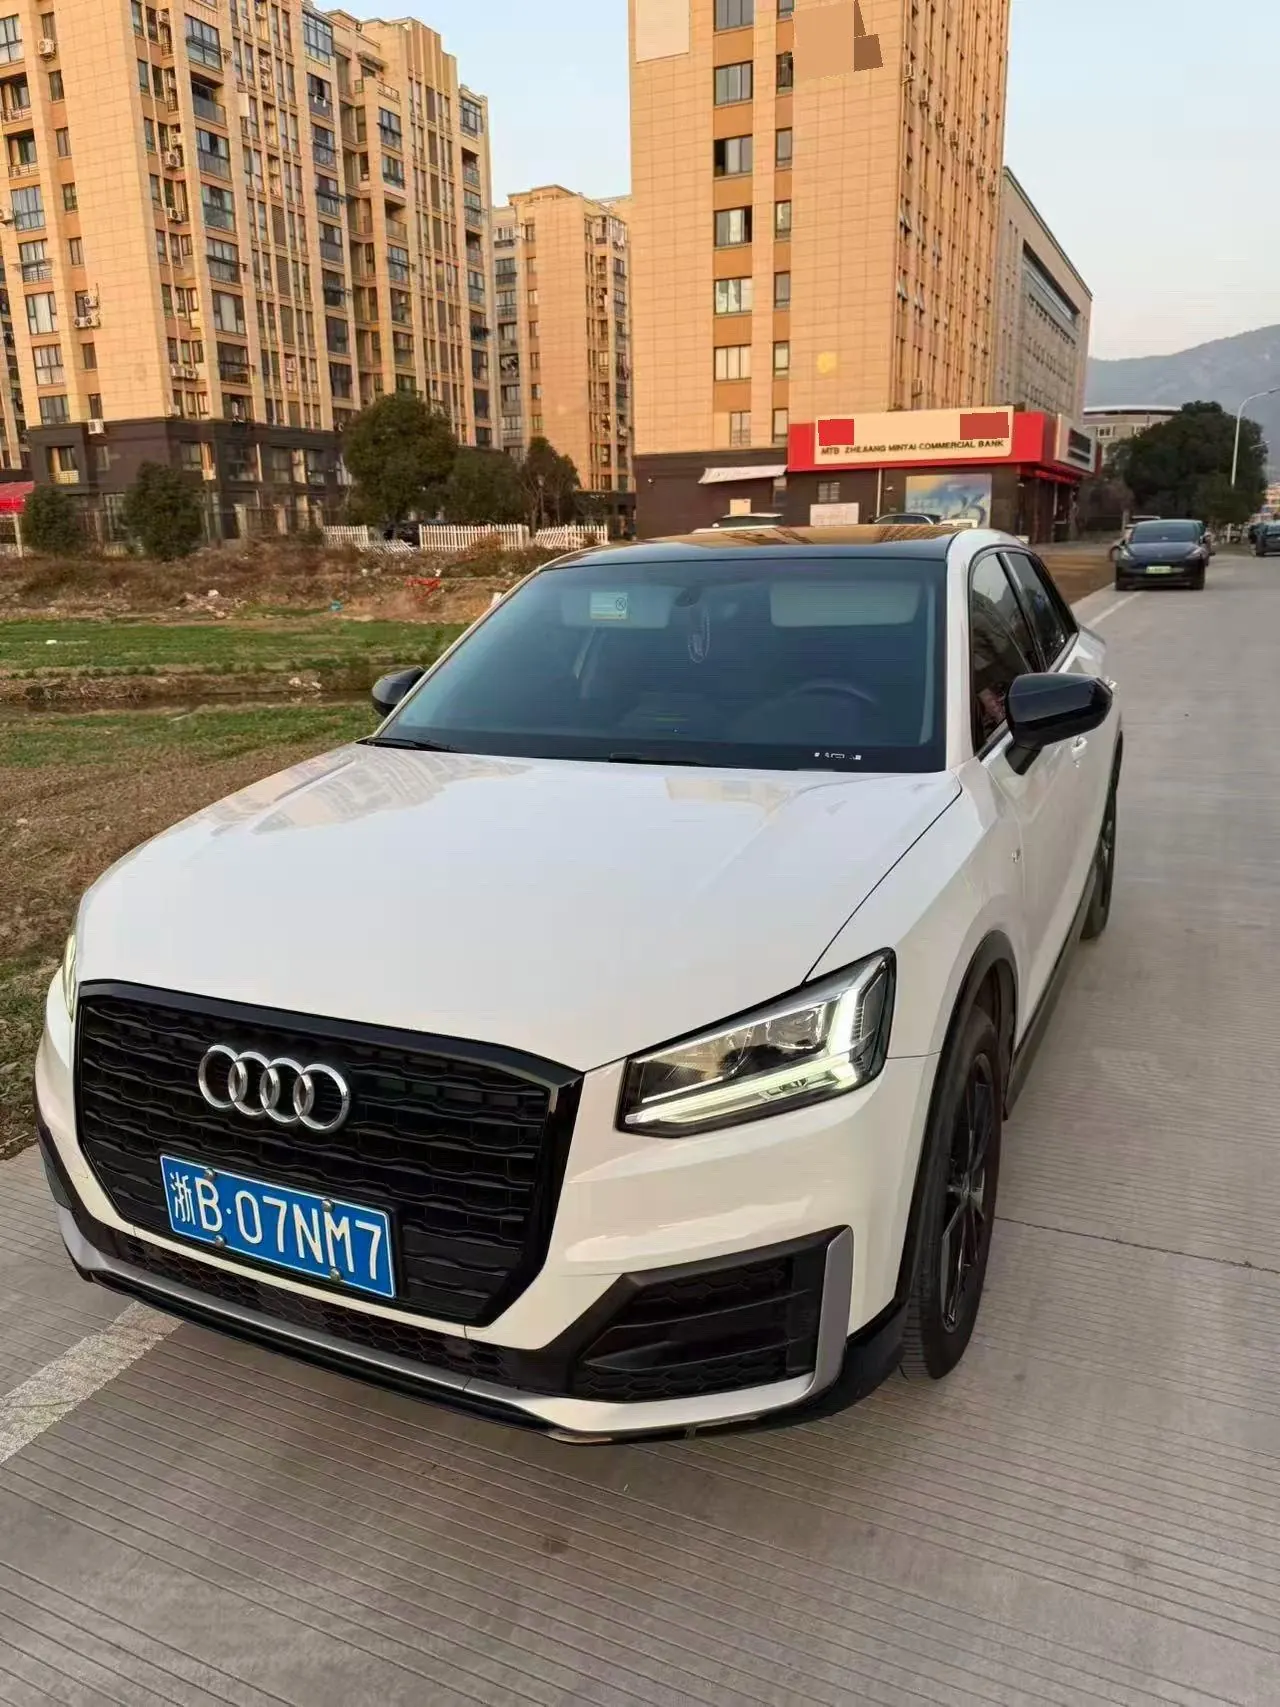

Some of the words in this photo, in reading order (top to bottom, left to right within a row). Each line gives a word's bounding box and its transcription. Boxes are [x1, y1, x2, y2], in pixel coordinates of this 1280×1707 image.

[821, 447, 840, 455] MTB
[888, 443, 916, 451] MINTAI
[919, 440, 975, 450] COMMERCIAL
[978, 439, 1004, 448] BANK
